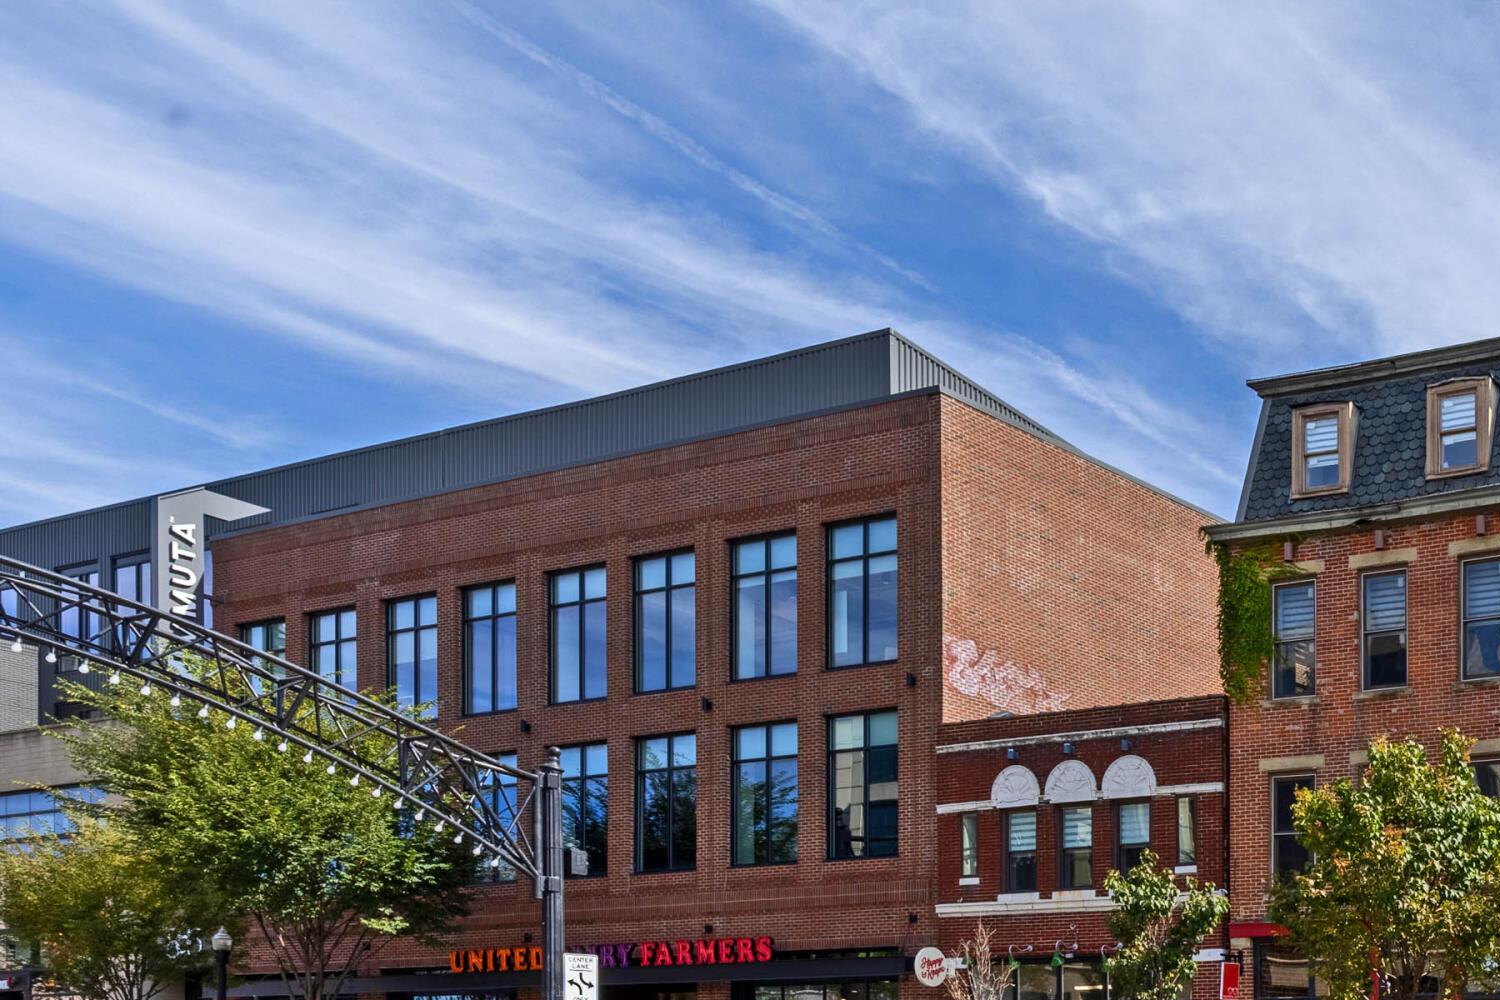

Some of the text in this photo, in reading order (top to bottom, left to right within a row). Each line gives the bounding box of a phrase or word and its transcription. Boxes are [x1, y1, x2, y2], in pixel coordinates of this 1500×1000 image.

[169, 523, 197, 640] MUTA
[450, 946, 543, 973] UNITED
[639, 936, 773, 967] FARMERS
